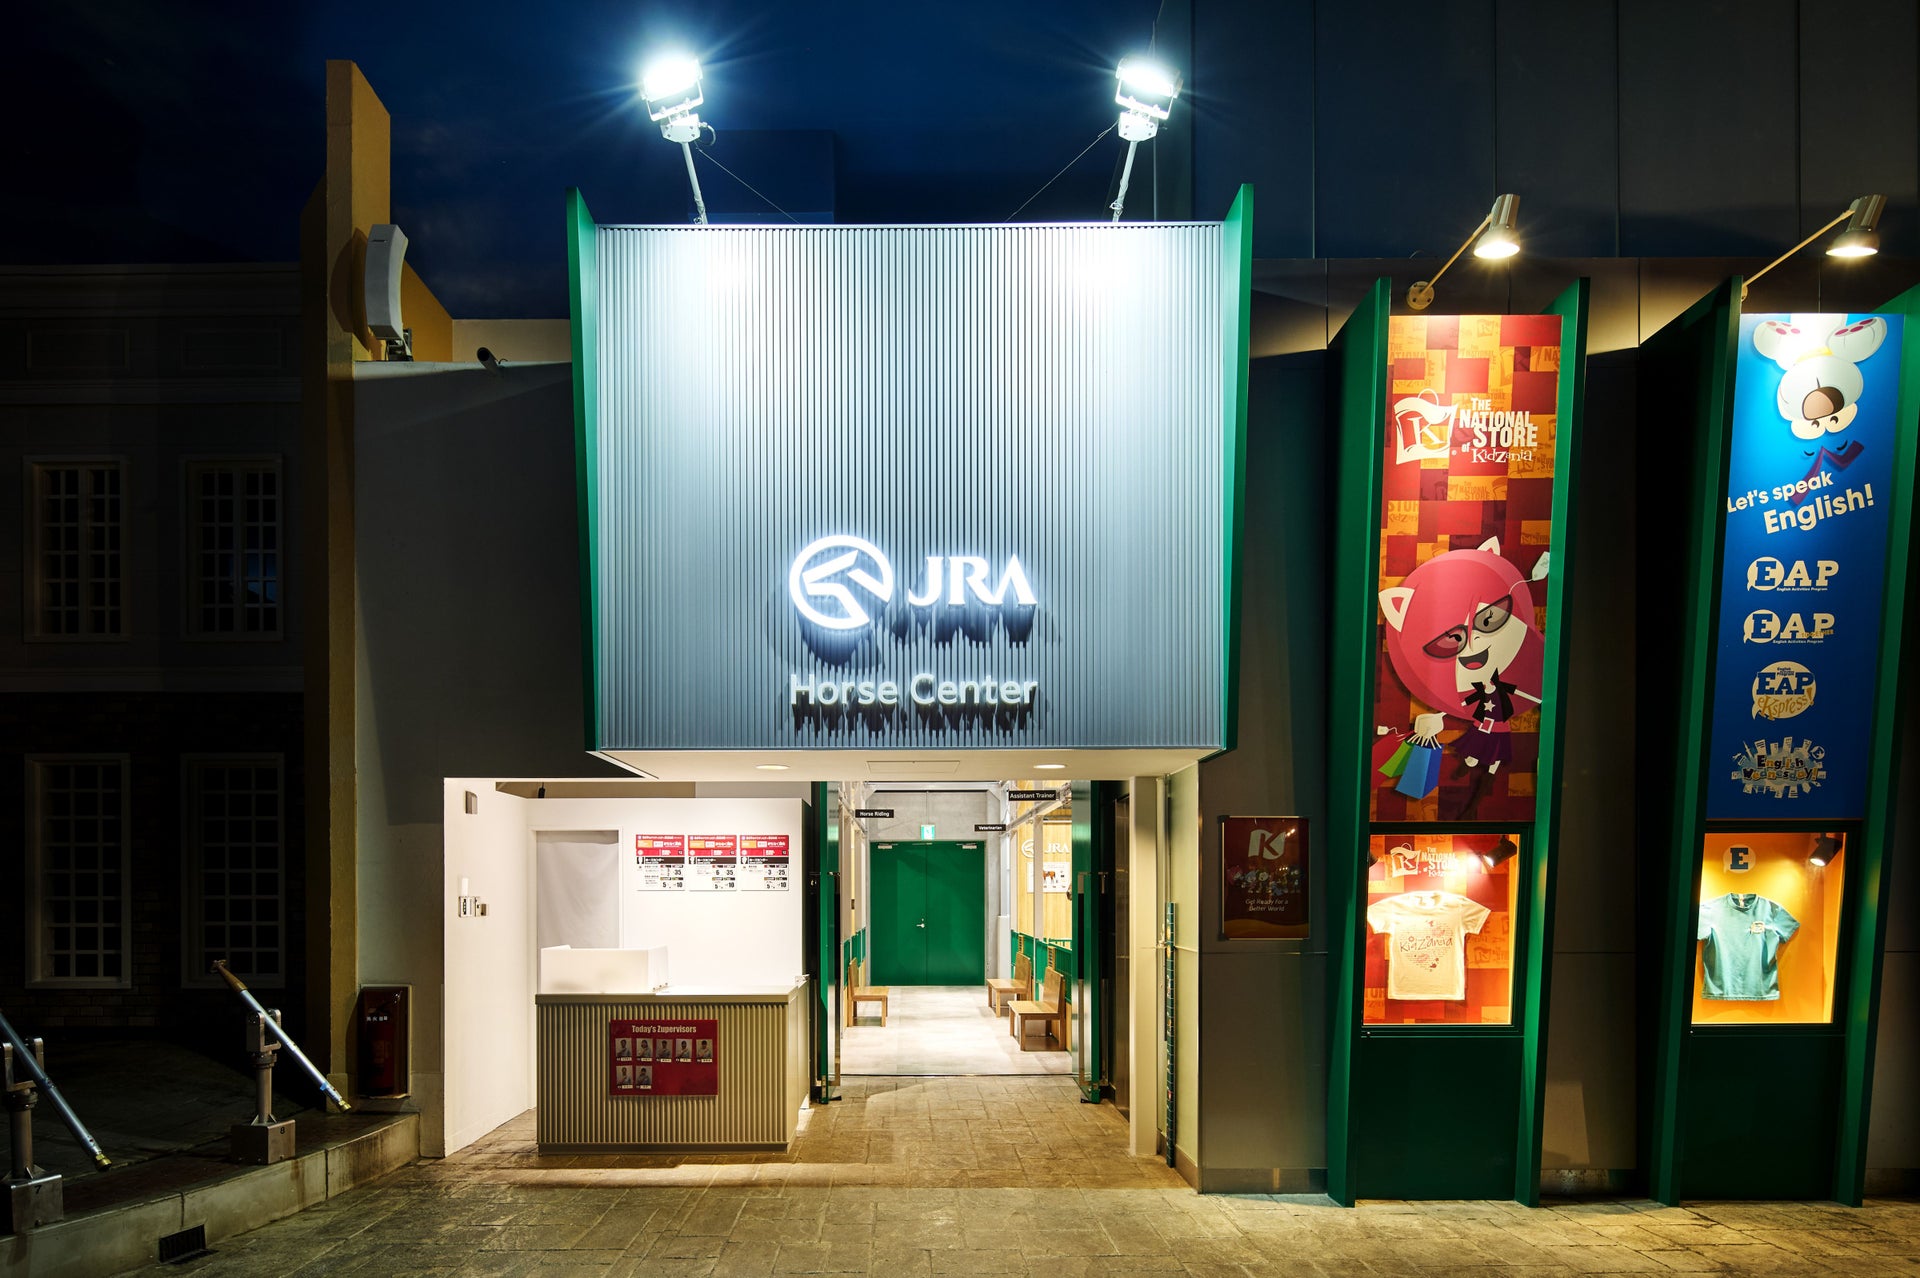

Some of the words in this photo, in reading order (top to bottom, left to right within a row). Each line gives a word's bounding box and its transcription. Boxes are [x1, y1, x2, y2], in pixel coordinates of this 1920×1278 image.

[1470, 397, 1491, 410] THE
[1460, 409, 1532, 431] NATIONAL
[1462, 442, 1471, 453] of
[1472, 424, 1538, 448] STORE
[1726, 489, 1769, 513] Let's
[1772, 471, 1834, 501] speak
[1763, 483, 1874, 534] English!
[908, 553, 1038, 606] JRA
[1753, 560, 1840, 588] EAP
[1750, 612, 1836, 639] EAP
[790, 674, 898, 705] Horse
[910, 673, 1038, 705] Center
[1756, 672, 1814, 695] EAP
[1757, 754, 1804, 770] English
[1044, 842, 1070, 853] JRA
[1730, 848, 1748, 870] E
[632, 1025, 657, 1033] Today's
[657, 1025, 696, 1033] Zupervisors
